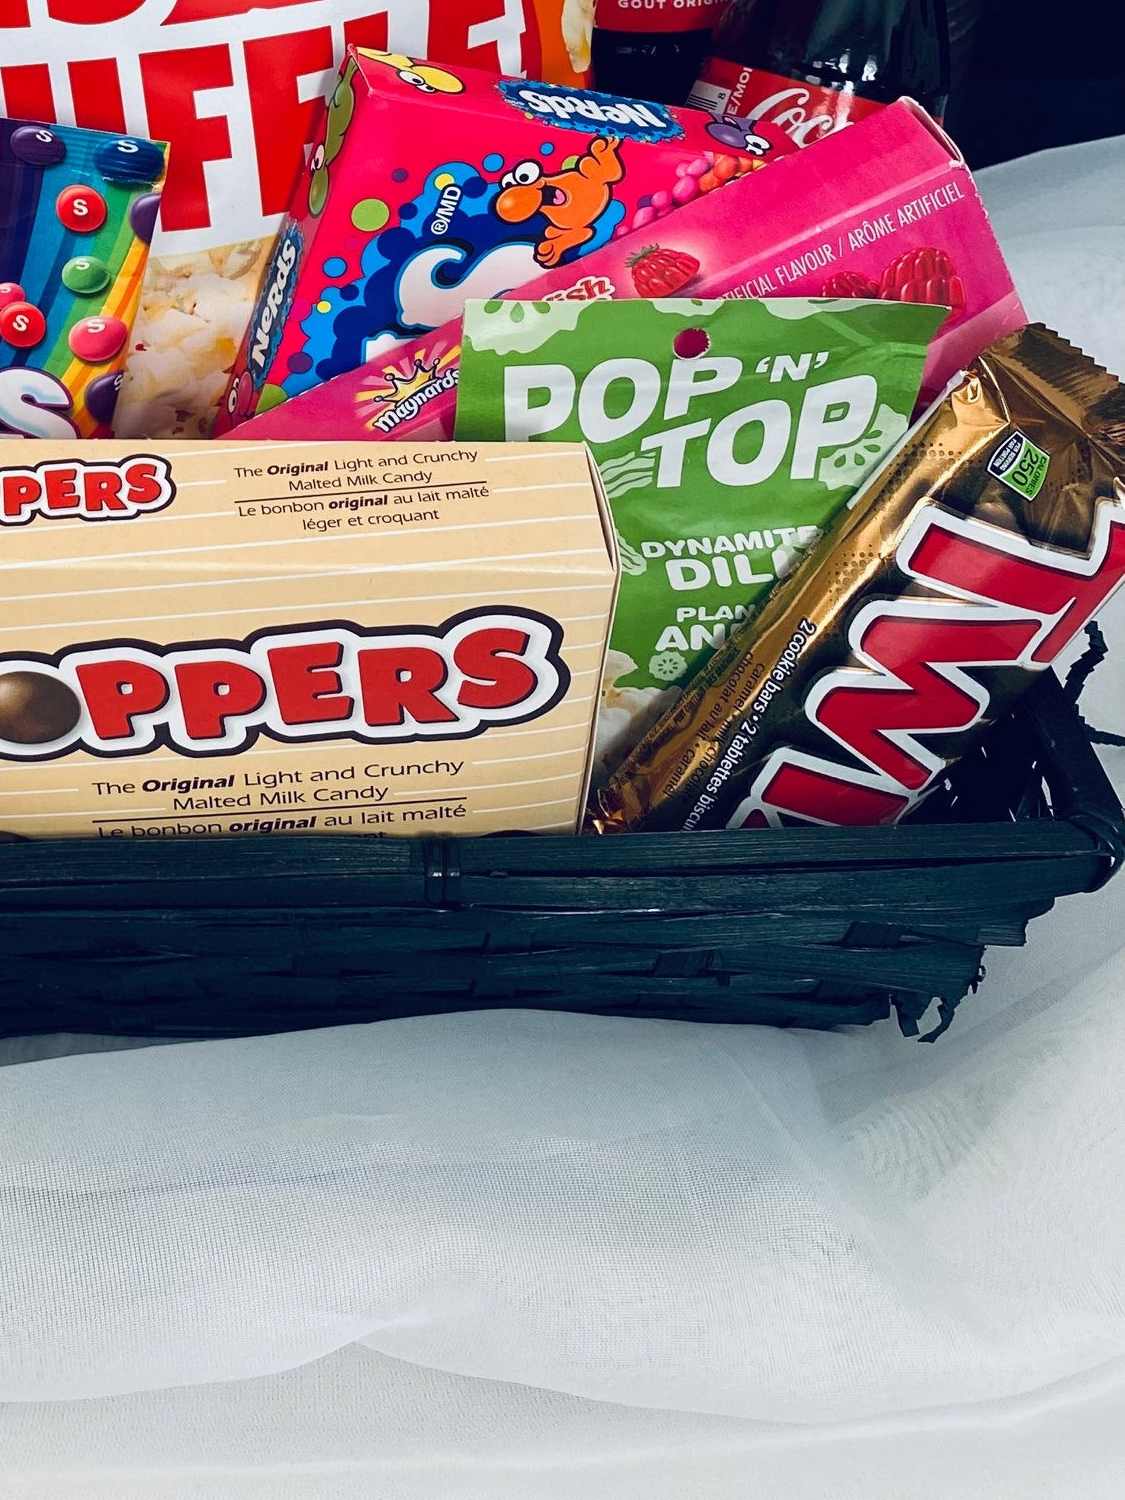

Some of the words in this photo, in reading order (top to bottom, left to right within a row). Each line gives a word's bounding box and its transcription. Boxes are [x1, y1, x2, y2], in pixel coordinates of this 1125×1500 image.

[773, 241, 838, 286] FLAVOUR
[842, 209, 897, 252] ARÔME
[892, 179, 966, 227] ARTIFICIEL
[503, 354, 744, 442] POP
[640, 374, 879, 489] TOP
[234, 466, 264, 478] The
[266, 461, 329, 476] Original
[334, 458, 374, 472] Light
[378, 455, 408, 466] and
[413, 449, 479, 464] Crunchy
[288, 477, 342, 492] Malted
[347, 473, 378, 487] Milk
[382, 470, 433, 484] Candy
[1009, 448, 1042, 487] 250
[1022, 456, 1050, 495] CALORIES
[238, 505, 257, 517] Le
[261, 499, 325, 516] bonbon
[328, 494, 388, 512] original
[393, 493, 413, 505] au
[418, 490, 442, 502] lait
[446, 486, 490, 501] malté
[303, 517, 342, 532] léger
[347, 515, 364, 526] et
[368, 509, 440, 527] croquant
[797, 618, 817, 636] 2
[743, 505, 1125, 826] TWI
[770, 632, 809, 683] cookie
[717, 650, 757, 704] chocolat
[730, 661, 768, 713] caramel
[706, 701, 724, 722] au
[751, 679, 781, 715] bars
[738, 720, 757, 737] 2
[92, 781, 136, 796] The
[141, 774, 236, 794] Original
[243, 769, 303, 789] Light
[310, 765, 355, 782] and
[363, 759, 465, 780] Crunchy
[661, 747, 699, 799] caramel
[704, 732, 750, 796] tablettes
[173, 793, 251, 811] Malted
[259, 790, 305, 807] Milk
[313, 785, 389, 806] Candy
[98, 826, 125, 839] Le
[131, 821, 223, 839] bonbon
[229, 815, 317, 835] original
[324, 814, 354, 827] au
[361, 809, 395, 825] lait
[402, 804, 468, 822] malté
